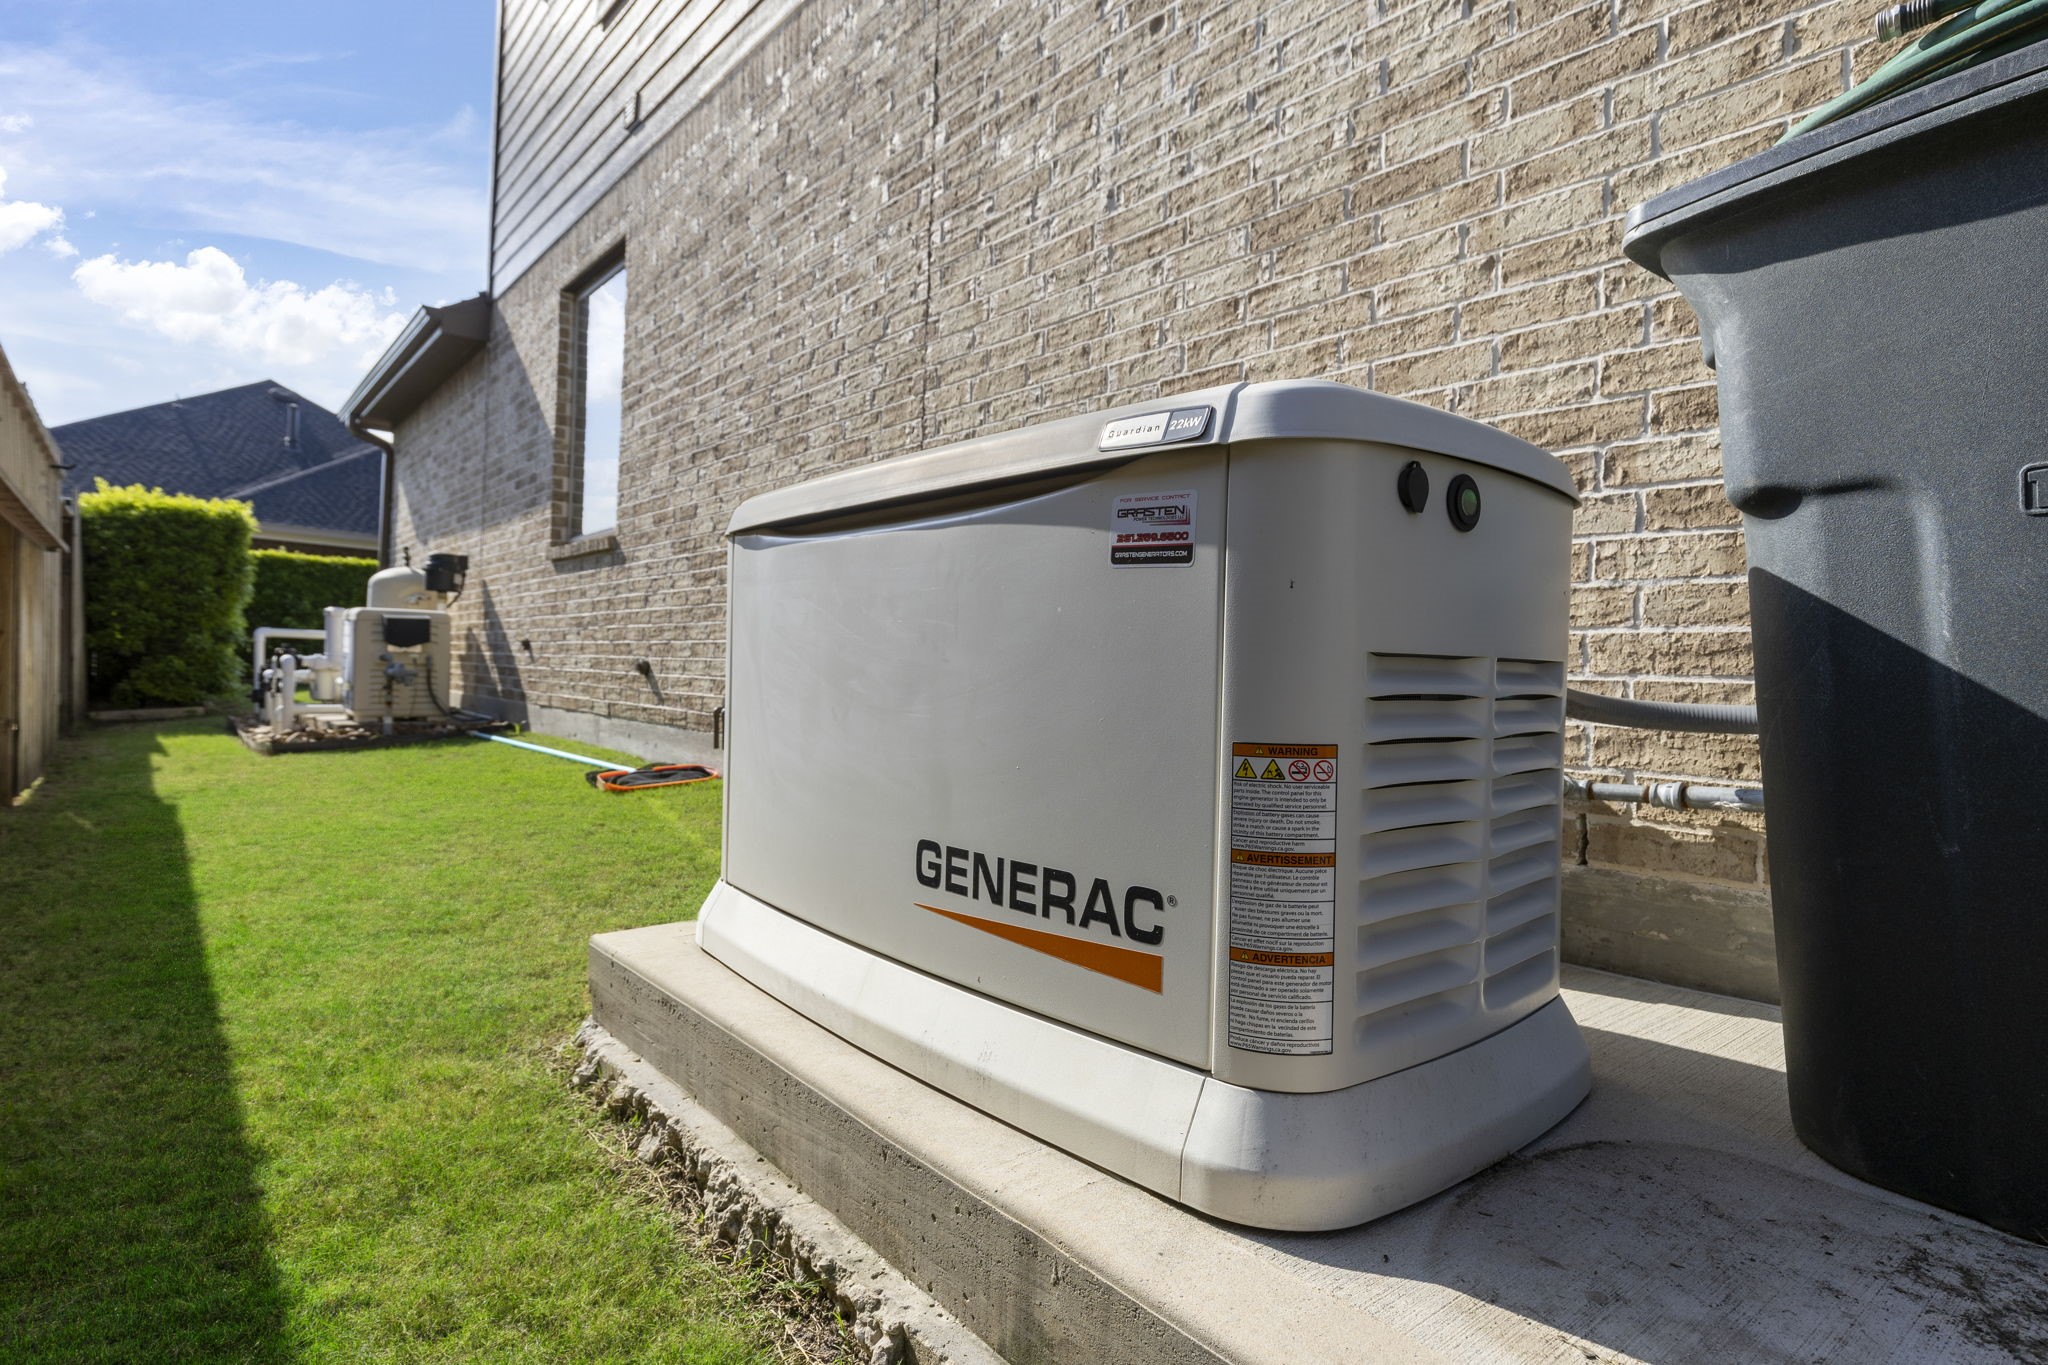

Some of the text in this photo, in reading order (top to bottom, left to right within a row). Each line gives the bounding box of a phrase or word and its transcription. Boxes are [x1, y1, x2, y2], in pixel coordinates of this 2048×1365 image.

[1108, 415, 1202, 438] Guardian 22kW
[1117, 505, 1185, 518] GRASTEN
[1268, 747, 1318, 756] WARNING
[1247, 854, 1332, 864] AVERTISSEMENT
[916, 838, 1165, 946] GENERAC
[1252, 953, 1326, 964] ADVERTENCIA
